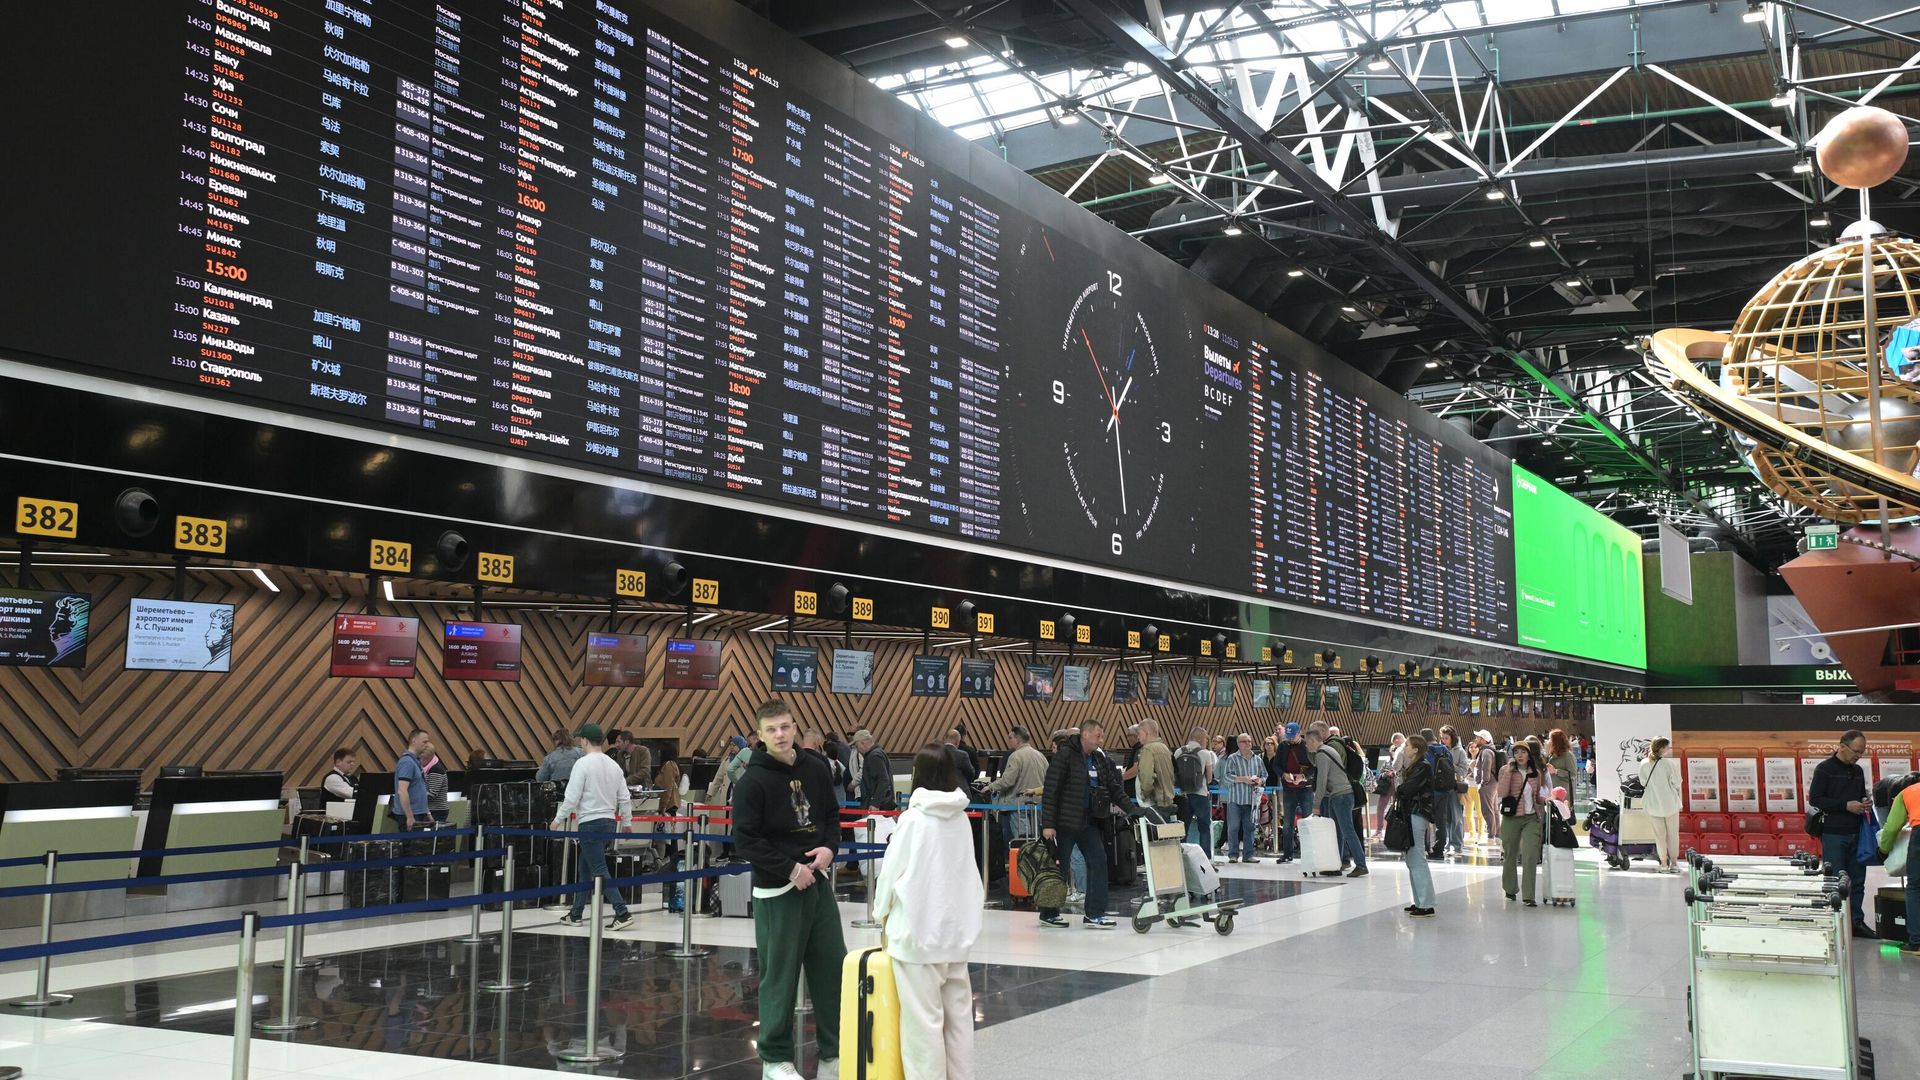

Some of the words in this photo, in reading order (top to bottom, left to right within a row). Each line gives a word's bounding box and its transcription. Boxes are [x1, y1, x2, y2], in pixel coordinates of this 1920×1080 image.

[217, 0, 270, 32] Волгоград
[437, 5, 461, 21] Посадка
[522, 2, 546, 20] Пермь
[216, 14, 246, 30] DP6969
[324, 20, 344, 39] 秋明
[188, 15, 211, 31] 14:20
[216, 25, 272, 56] Махачкала
[522, 23, 580, 56] Санкт-Петербург
[186, 41, 210, 56] 14:25
[215, 50, 239, 69] Баку
[216, 39, 244, 55] SU1058
[324, 45, 370, 73] 伏尔加格勒
[521, 43, 568, 71] Екатеринбург
[734, 58, 748, 71] 13:28
[185, 67, 209, 82] 14:25
[213, 75, 234, 92] Уфа
[214, 64, 244, 80] SU1856
[434, 70, 459, 86] Посадка
[520, 64, 578, 96] Санкт-Петербург
[323, 68, 369, 97] 马哈奇卡拉
[402, 80, 429, 97] 365-373
[184, 93, 208, 108] 14:30
[212, 102, 238, 118] Сочи
[213, 90, 242, 106] SU1232
[401, 90, 429, 106] 431-436
[434, 93, 471, 114] Регистрация
[520, 86, 556, 107] Астрахань
[397, 101, 402, 109] B
[402, 102, 429, 119] 319-364
[520, 106, 558, 129] Махачкала
[212, 116, 241, 130] SU1128
[183, 119, 206, 133] 14:35
[211, 127, 265, 155] Волгоград
[396, 124, 401, 132] C
[402, 126, 429, 142] 408-430
[519, 127, 564, 152] Владивосток
[210, 142, 240, 156] SU1182
[732, 148, 753, 164] 17:00
[182, 145, 206, 159] 14:40
[210, 152, 276, 183] Нижнекамск
[210, 168, 240, 181] SU1680
[181, 171, 205, 185] 14:40
[209, 178, 247, 198] Ереван
[208, 192, 238, 207] SU1862
[518, 193, 545, 213] 16:00
[180, 197, 203, 211] 14:45
[207, 204, 249, 224] Тюмень
[208, 219, 233, 231] N4163
[178, 224, 202, 237] 14:45
[206, 230, 241, 248] Минск
[731, 234, 759, 252] Волгоград
[206, 245, 236, 258] SU1842
[207, 260, 247, 281] 15:00
[515, 275, 540, 290] Казань
[1107, 270, 1122, 296] 12
[176, 276, 200, 289] 15:00
[204, 282, 272, 309] Калининград
[204, 296, 234, 309] SU1018
[514, 296, 553, 315] Чебоксары
[174, 303, 199, 315] 15:00
[203, 308, 240, 325] Казань
[313, 310, 360, 332] 加里宁格勒
[889, 316, 905, 329] 19:00
[1062, 295, 1083, 350] SHEREMETYEVO
[1082, 282, 1098, 299] AIRPORT
[514, 318, 560, 339] Калининград
[1137, 312, 1151, 343] MOSCOW
[1207, 325, 1219, 338] 13:28
[173, 330, 197, 342] 15:05
[202, 334, 254, 354] Мин.Воды
[312, 335, 332, 350] 喀山
[201, 349, 232, 360] SU1300
[1204, 344, 1232, 370] Вылеты
[172, 356, 196, 368] 15:10
[200, 361, 262, 382] Ставрополь
[312, 359, 341, 376] 矿水城
[512, 361, 552, 378] Махачкала
[1204, 361, 1242, 391] Departures
[200, 375, 230, 386] SU1362
[729, 382, 751, 396] 18:00
[1053, 380, 1064, 404] 9
[1204, 384, 1209, 396] B
[1210, 388, 1215, 399] C
[1216, 390, 1221, 402] D
[1222, 392, 1227, 405] E
[1228, 395, 1232, 406] F
[511, 404, 542, 419] Стамбул
[728, 398, 748, 409] Ереван
[511, 426, 569, 446] Шарм-эль-Шейх
[1161, 422, 1171, 442] 3
[728, 435, 764, 450] Калининград
[727, 472, 762, 485] Владивосток
[21, 503, 74, 532] 382
[179, 522, 223, 547] 383
[1112, 533, 1122, 555] 6
[374, 545, 409, 567] 384
[481, 557, 512, 578] 385
[618, 573, 644, 593] 386
[694, 582, 717, 601] 387
[137, 606, 186, 615] Шереметьево
[796, 594, 815, 611] 388
[854, 601, 872, 617] 389
[136, 615, 169, 624] аэропорт
[933, 610, 948, 625] 390
[979, 616, 993, 630] 391
[152, 624, 184, 632] Пушкина
[1042, 623, 1054, 636] 392
[1078, 628, 1089, 640] 393
[1129, 633, 1139, 645] 394
[1160, 637, 1169, 649] 395
[1808, 744, 1840, 754] СКОР
